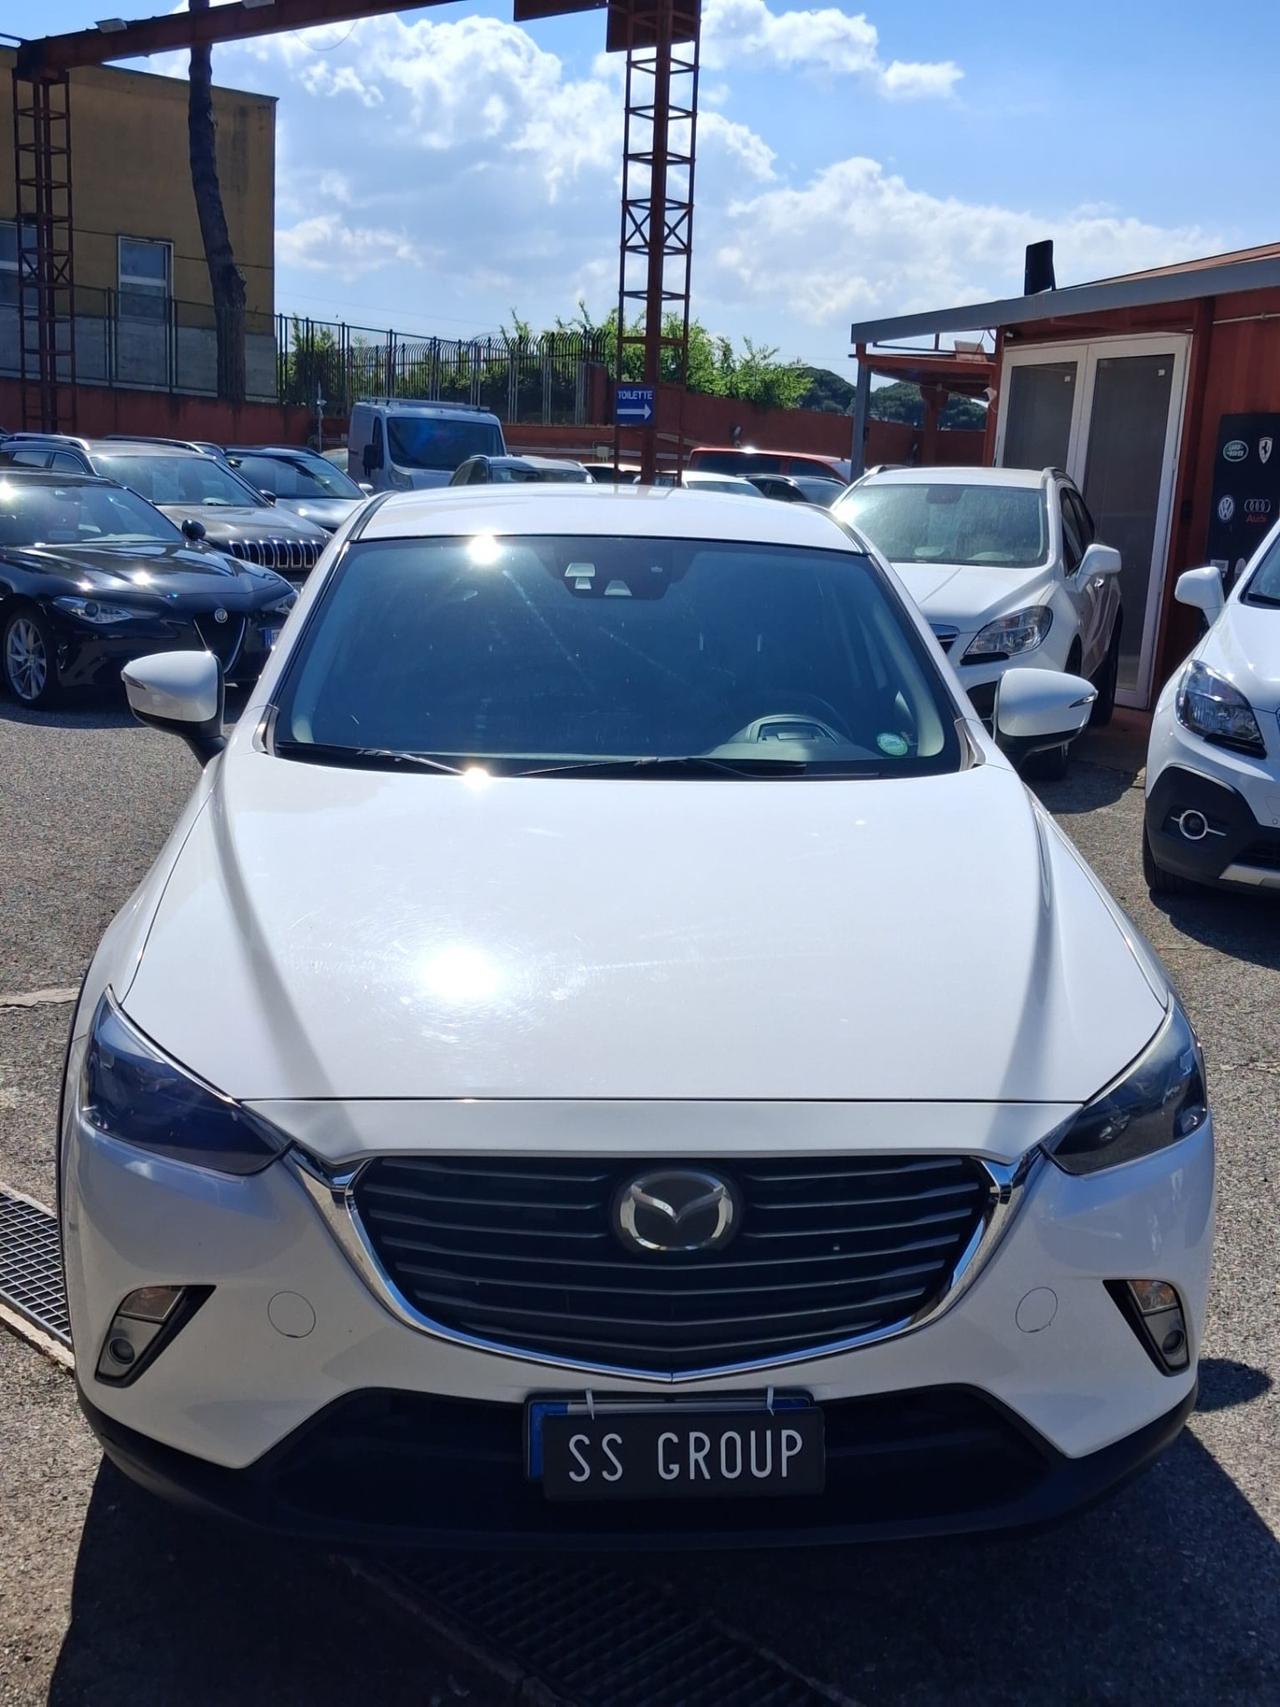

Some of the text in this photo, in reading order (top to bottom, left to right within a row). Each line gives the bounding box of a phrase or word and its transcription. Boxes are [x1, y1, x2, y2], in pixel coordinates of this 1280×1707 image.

[617, 390, 653, 400] TOILETTE
[568, 1429, 803, 1482] SS GROUP
